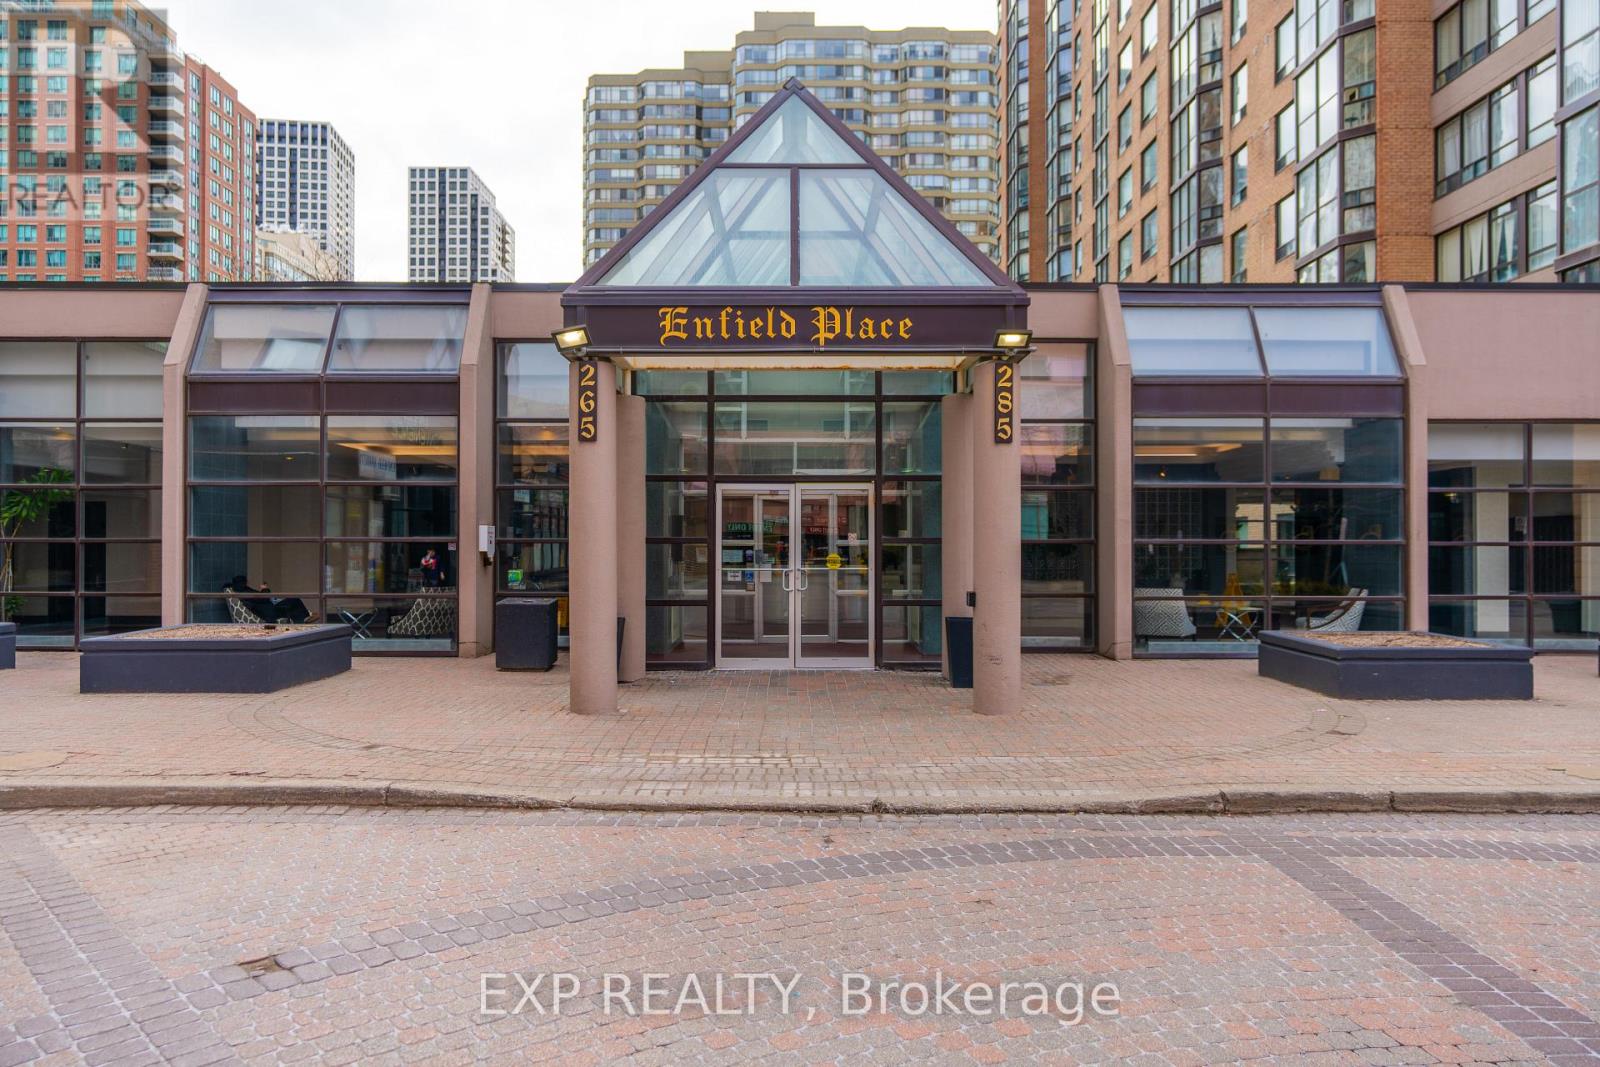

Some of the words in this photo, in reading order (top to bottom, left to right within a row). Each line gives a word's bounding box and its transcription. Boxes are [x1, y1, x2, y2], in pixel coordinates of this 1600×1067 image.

[658, 306, 797, 346] Enfield
[810, 306, 913, 347] Place
[579, 365, 597, 440] 265
[997, 365, 1014, 440] 285
